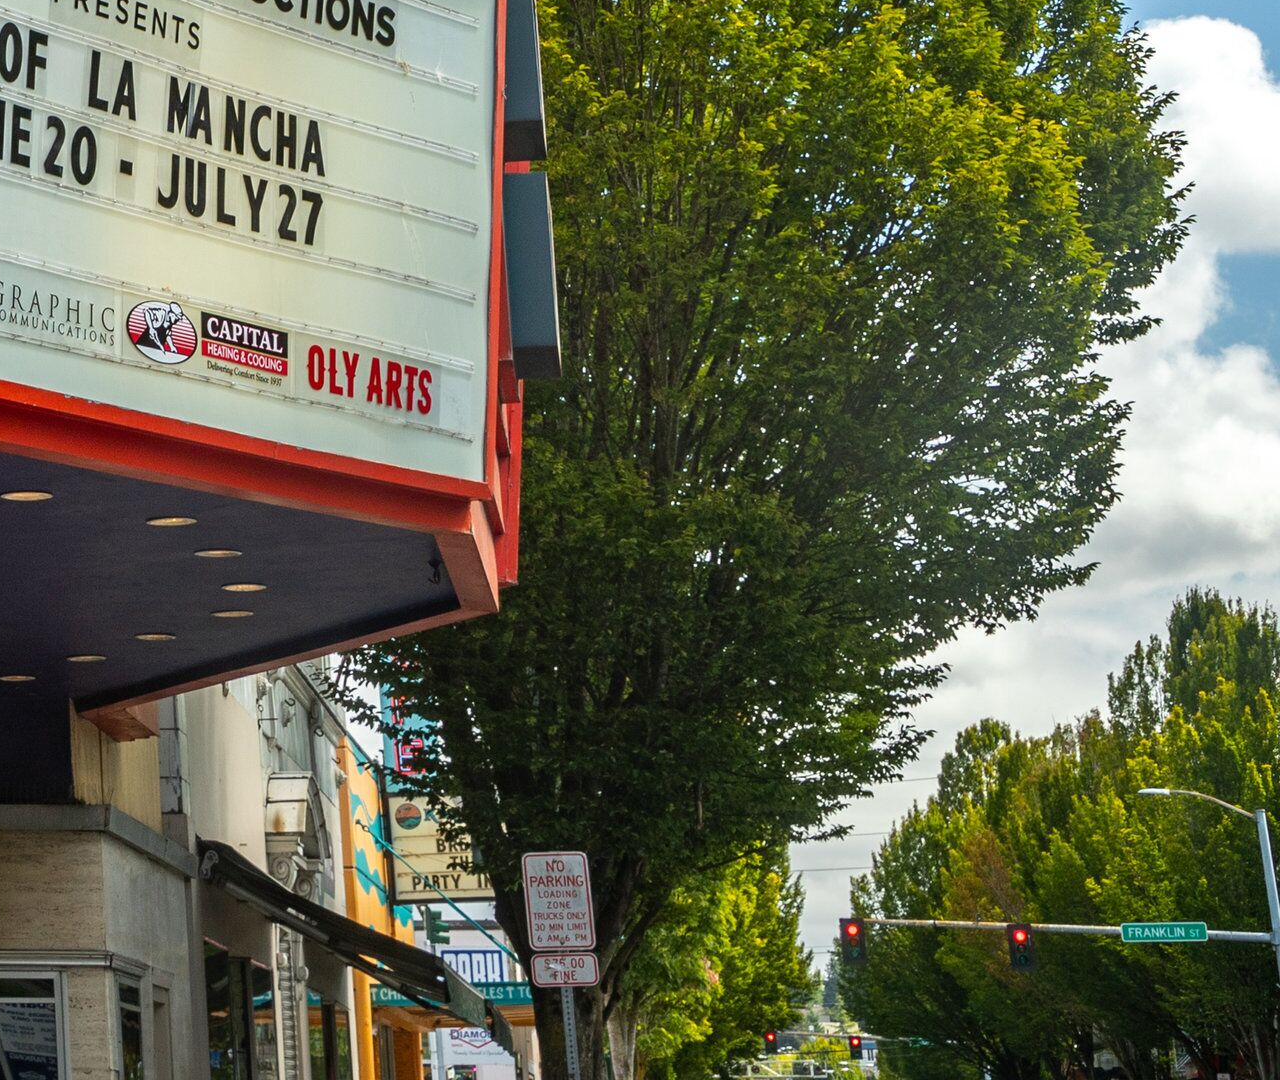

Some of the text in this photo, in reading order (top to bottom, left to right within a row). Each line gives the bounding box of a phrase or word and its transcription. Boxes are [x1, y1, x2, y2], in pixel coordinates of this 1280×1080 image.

[88, 50, 137, 121] LA
[167, 76, 326, 177] MANCHA
[207, 317, 283, 354] CAPITAL
[207, 342, 282, 372] HEATING & COOLING
[207, 360, 233, 376] Delivering
[234, 366, 255, 380] Comfort
[256, 373, 269, 384] Since
[307, 344, 432, 415] OLY ARTS
[545, 860, 565, 872] NO
[412, 874, 461, 890] PARTY
[530, 875, 584, 888] PARKING
[538, 889, 578, 899] LOADING
[547, 901, 571, 909] ZONE
[533, 912, 586, 920] TRUCKS ONLY
[534, 923, 587, 932] 30 MIN LIMIT
[1128, 927, 1200, 938] FRANKLIN ST
[537, 934, 543, 942] 6
[553, 970, 578, 981] FINE
